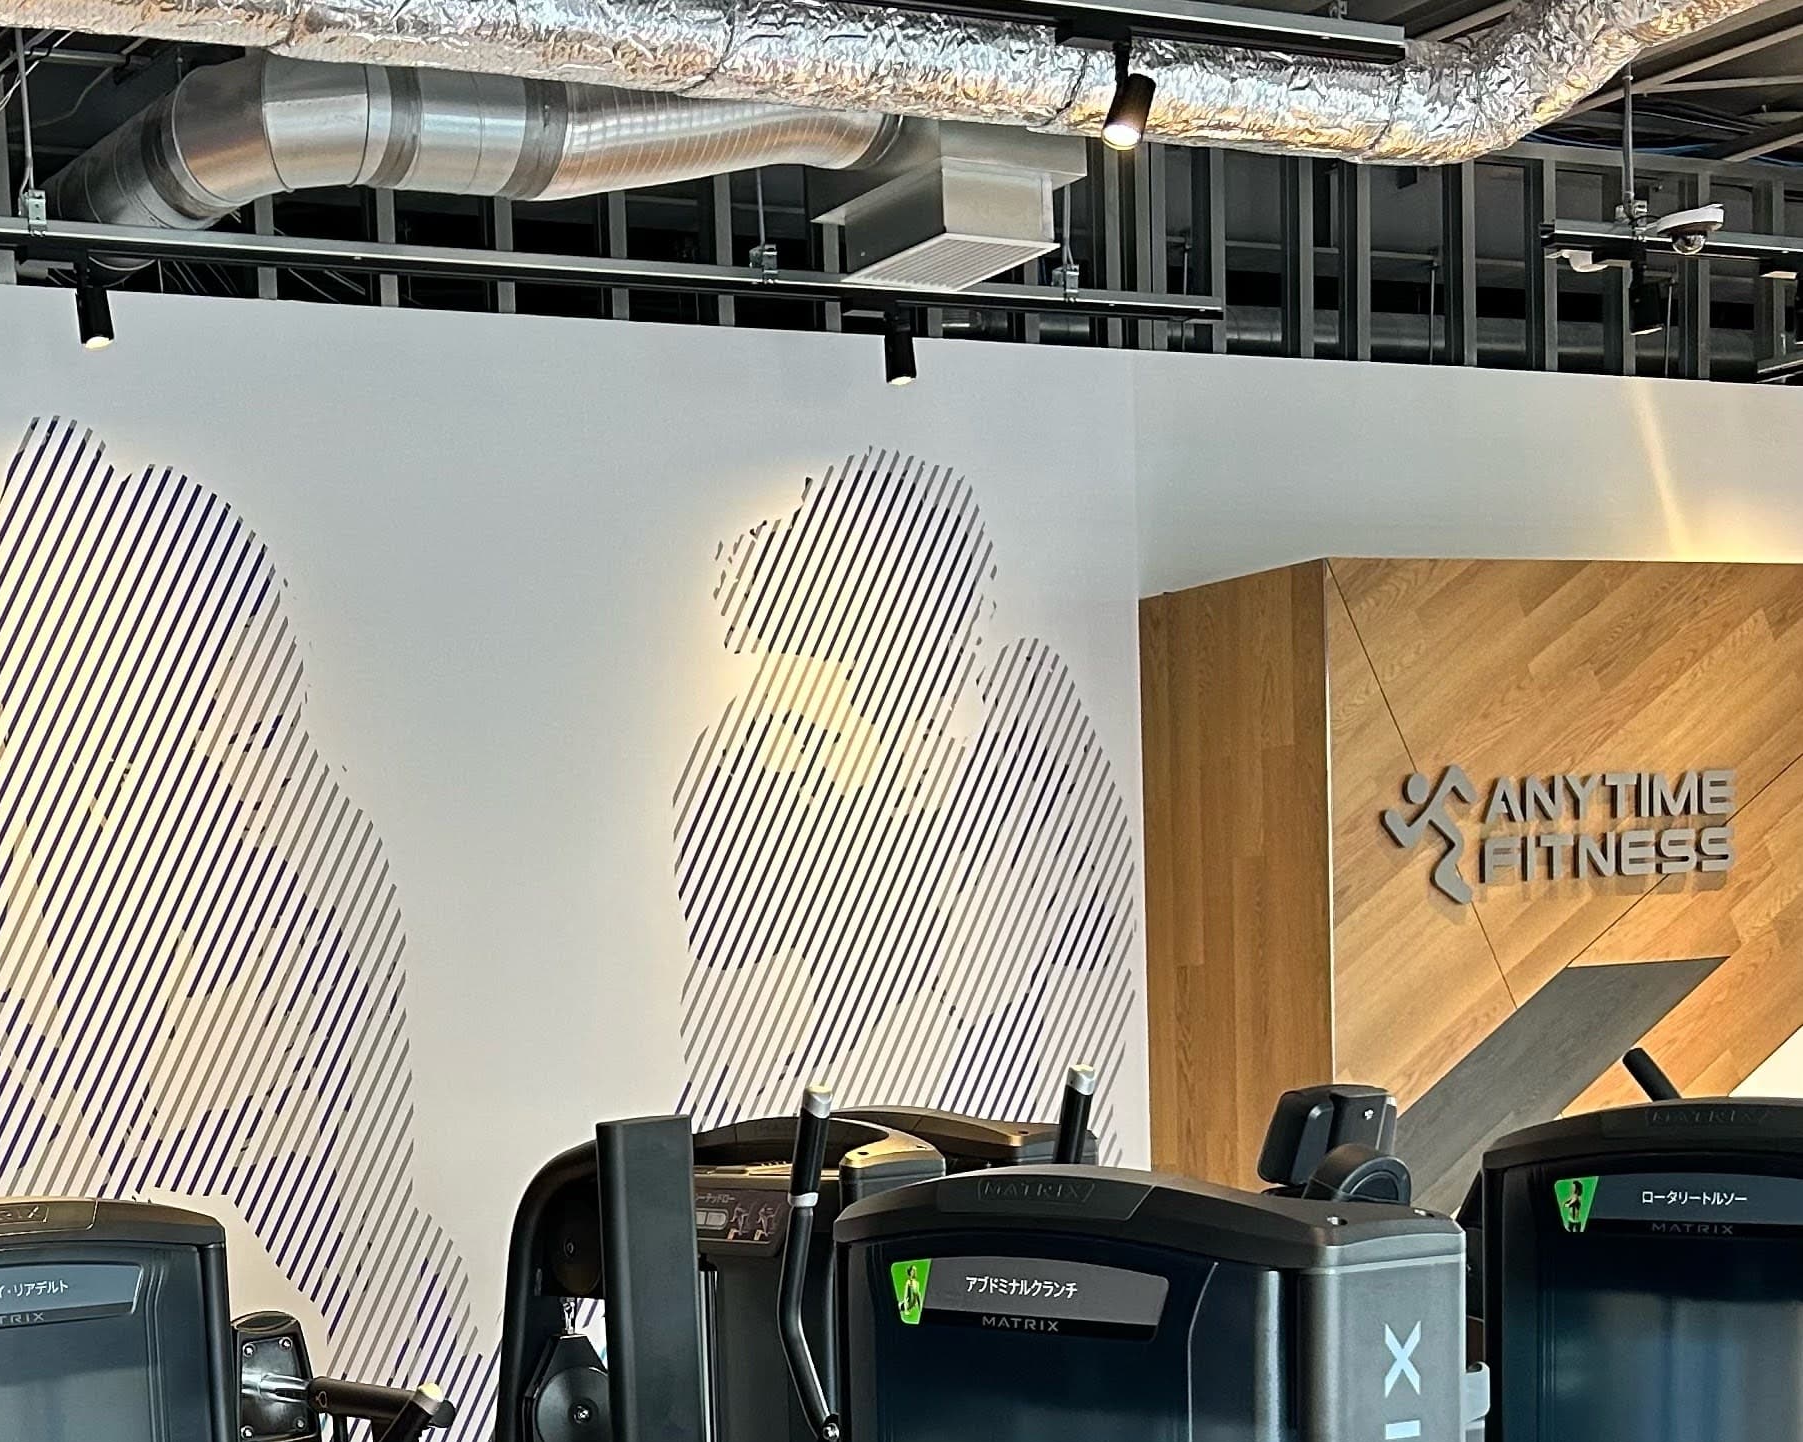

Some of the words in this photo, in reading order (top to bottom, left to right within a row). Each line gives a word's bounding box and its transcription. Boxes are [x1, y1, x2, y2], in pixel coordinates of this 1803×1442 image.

[1484, 769, 1734, 824] ANYTIME
[1481, 826, 1734, 884] FITNESS
[984, 1180, 1081, 1198] MATRIX
[1642, 1191, 1747, 1206] ロータリートルソー
[1652, 1222, 1734, 1235] MATRIX
[965, 1276, 1078, 1299] アブドミナルクランチ
[982, 1315, 1060, 1333] MATRIX
